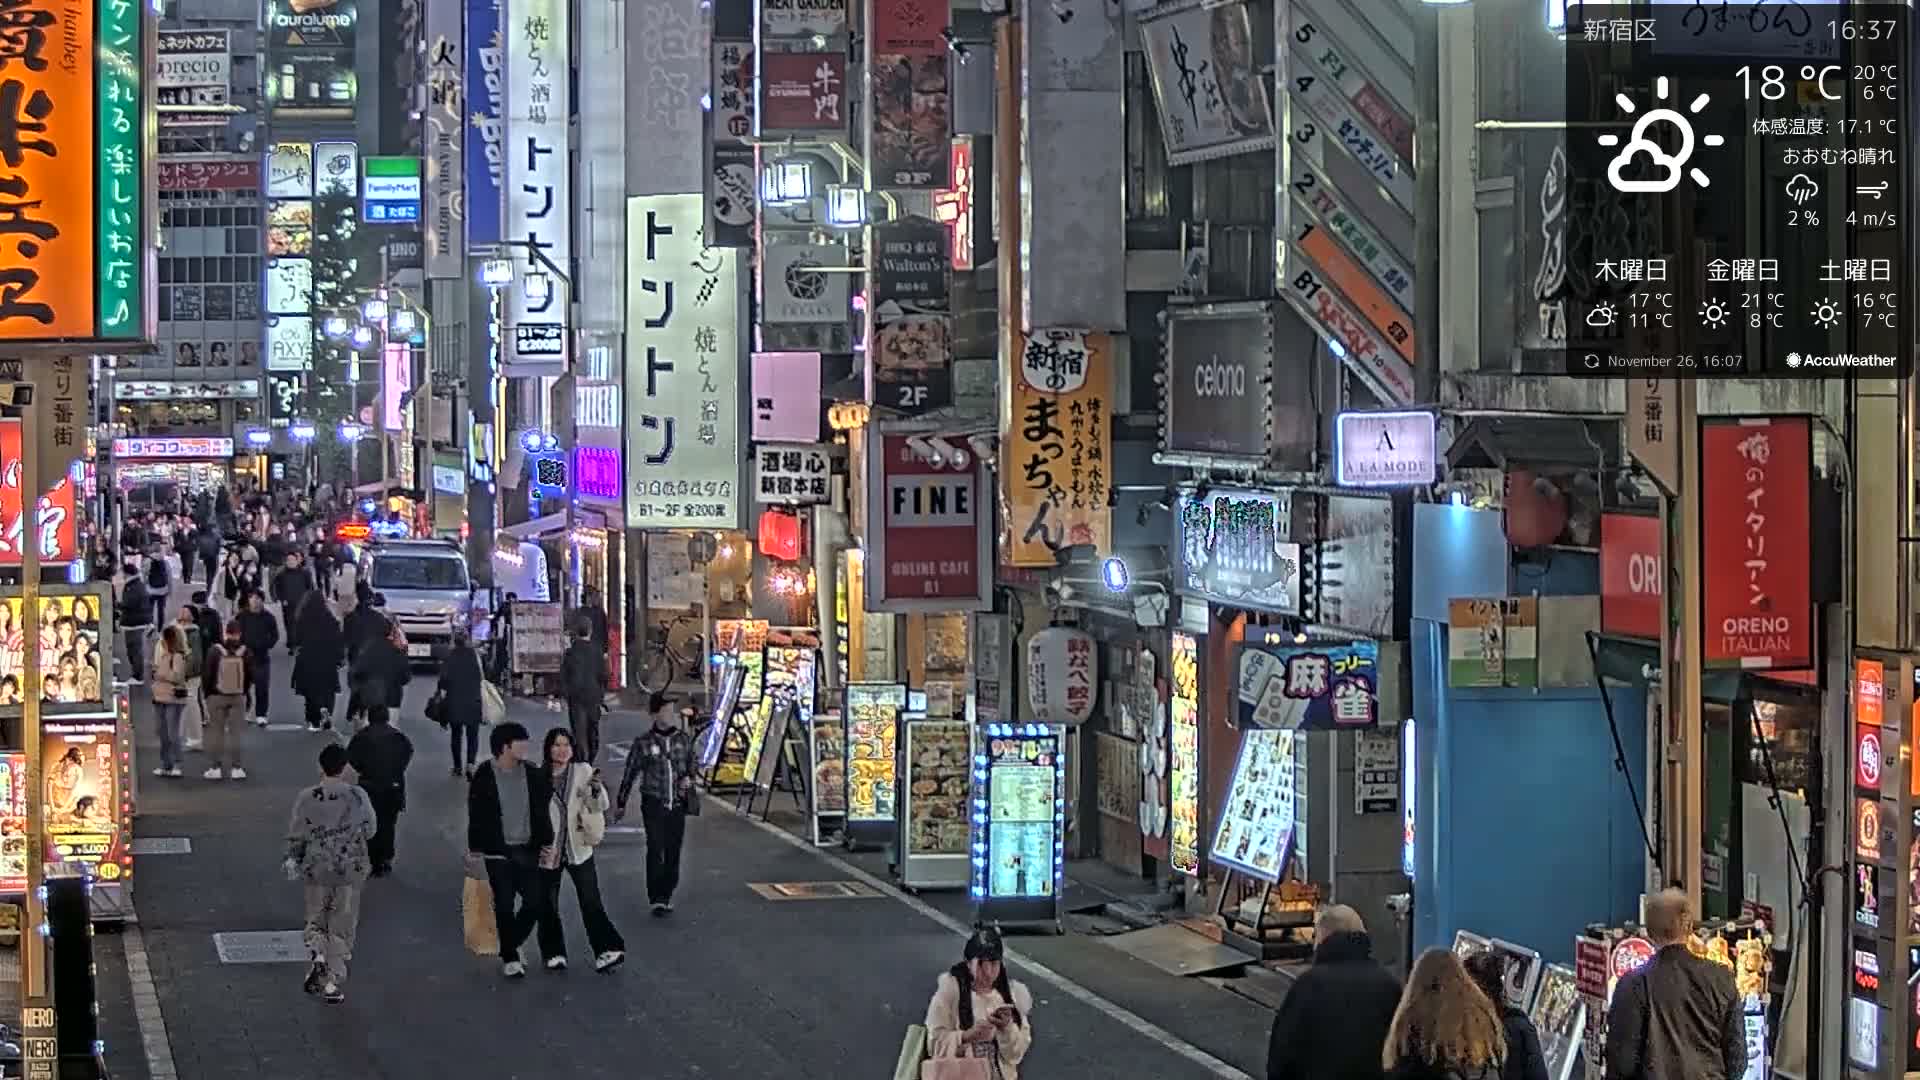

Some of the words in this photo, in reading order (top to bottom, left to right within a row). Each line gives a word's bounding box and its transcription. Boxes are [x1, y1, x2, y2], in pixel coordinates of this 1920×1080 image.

[277, 13, 350, 27] auralume
[1296, 23, 1317, 43] 5
[813, 61, 840, 121] 牛門
[1296, 76, 1316, 92] 4
[1296, 123, 1316, 143] 3
[1338, 118, 1393, 180] センチュリー
[1294, 174, 1315, 194] 2
[883, 256, 941, 273] Walton's
[1293, 270, 1321, 299] B1
[641, 210, 676, 465] トントン
[1025, 341, 1083, 374] 新宿
[1044, 374, 1065, 390] の
[1194, 355, 1246, 397] celona
[899, 387, 928, 406] 2F
[761, 451, 826, 472] 酒場心
[1021, 397, 1064, 552] まっちゃん
[761, 475, 826, 495] 新宿本店
[892, 486, 967, 514] FINE
[1736, 431, 1771, 605] 俺のイタリアン
[1722, 617, 1788, 634] ORENO
[1721, 634, 1790, 653] ITALIAN
[23, 1008, 54, 1027] NERO
[26, 1039, 56, 1057] NERO
